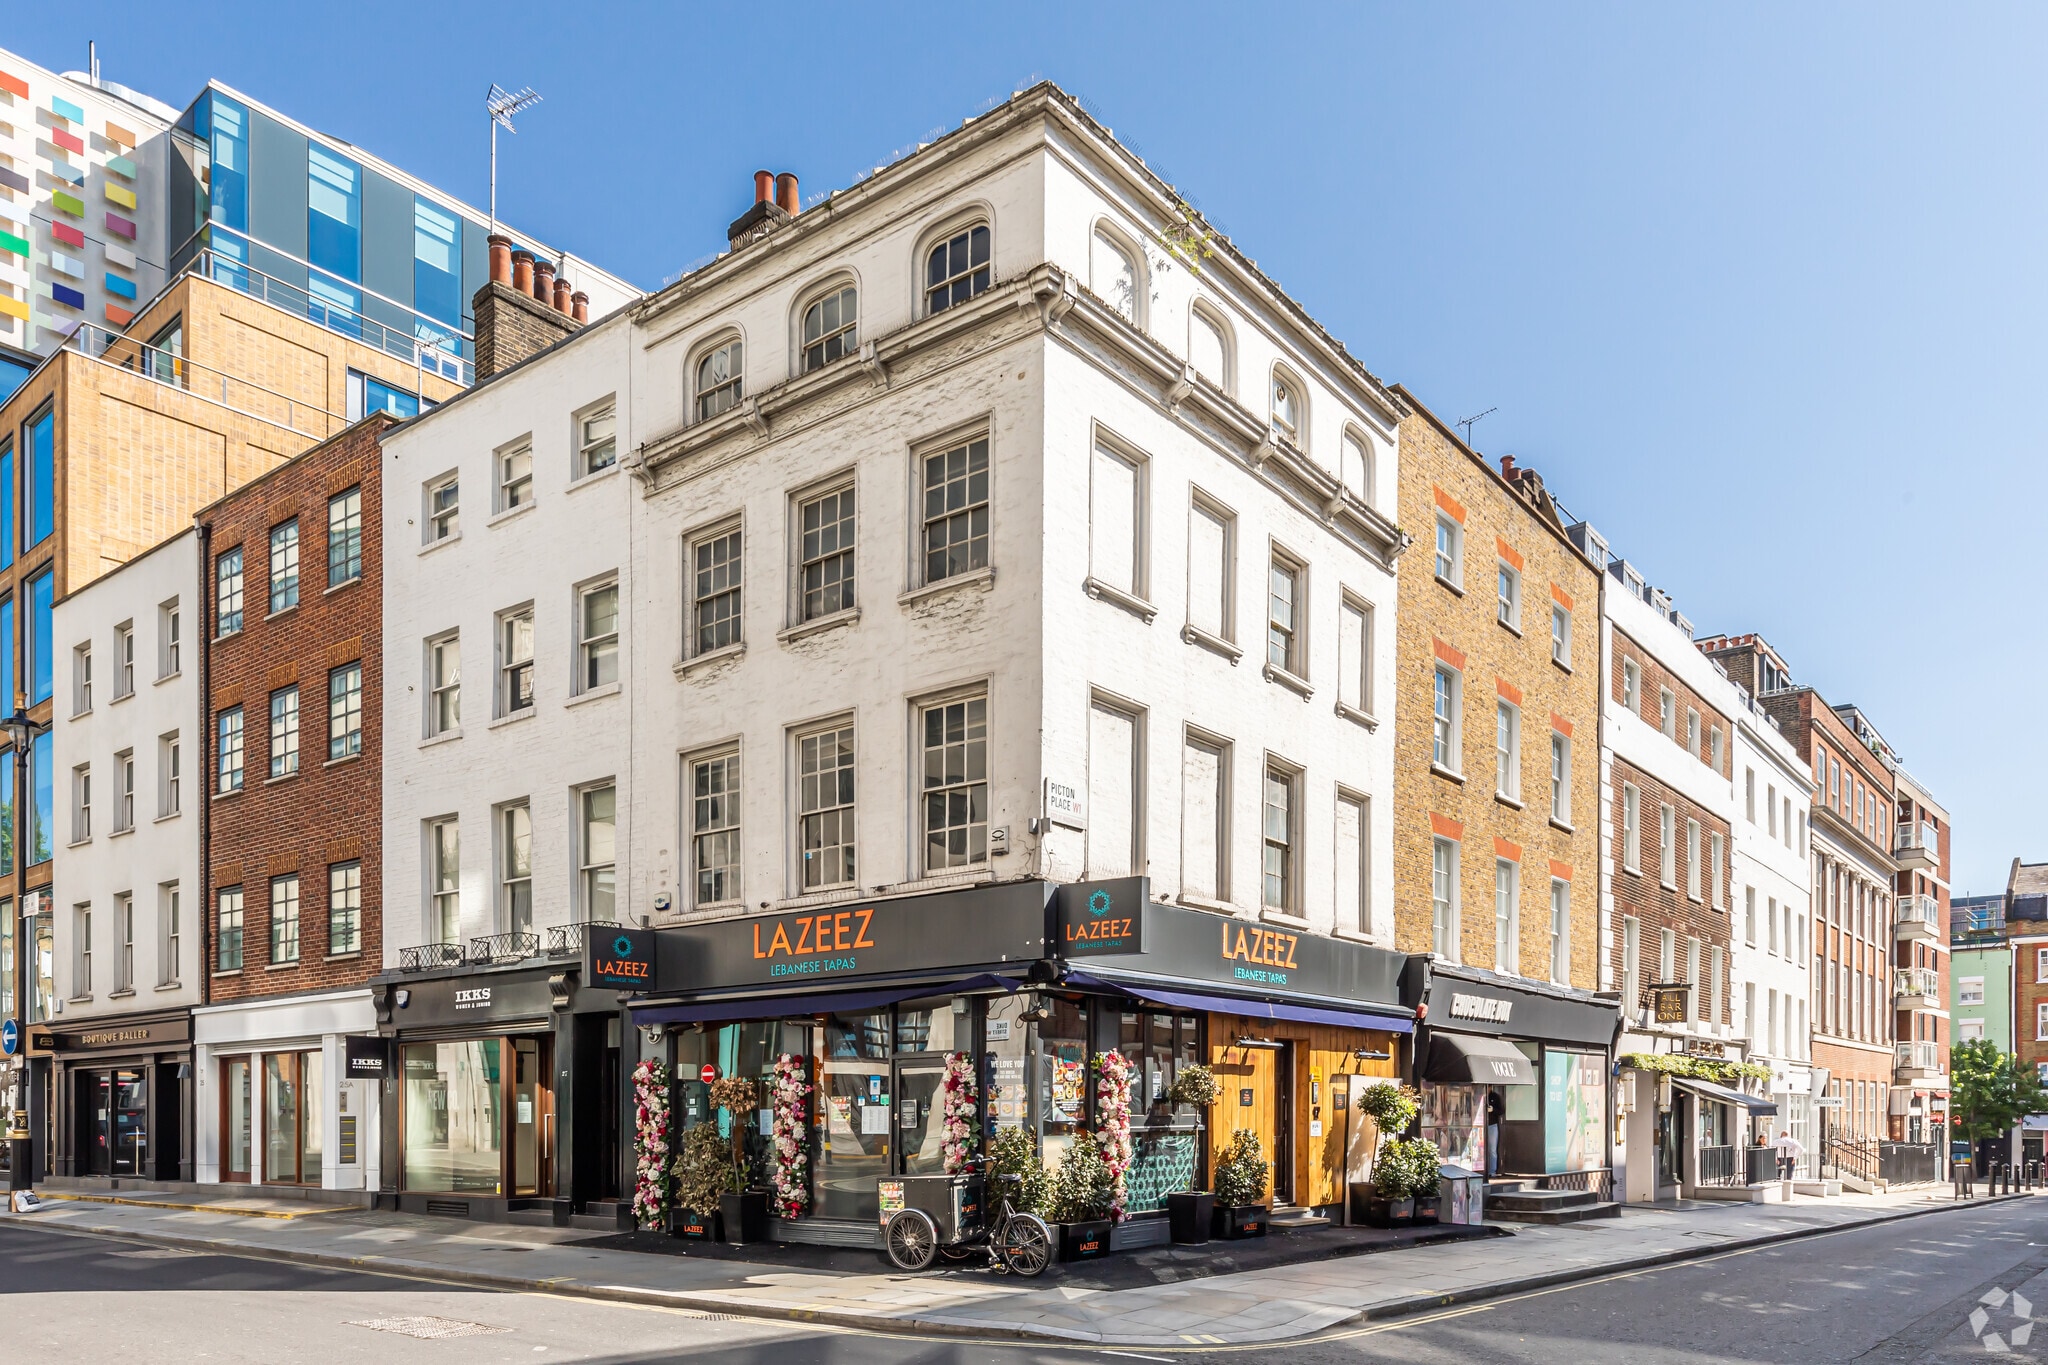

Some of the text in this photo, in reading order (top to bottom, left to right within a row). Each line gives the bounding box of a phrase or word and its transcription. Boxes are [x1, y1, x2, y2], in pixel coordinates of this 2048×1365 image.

[1051, 783, 1075, 799] PICTON
[1051, 796, 1071, 811] PLACE
[754, 909, 875, 959] LAZEEZ
[1066, 918, 1132, 941] LAZEEZ
[1223, 922, 1298, 969] LAZEEZ
[597, 960, 649, 977] LAZEEZ
[770, 957, 856, 976] LEBANESE TAPAS
[1234, 967, 1287, 985] LEBANESE TAPAS
[455, 988, 491, 1002] IKKS
[1661, 993, 1681, 1002] ALL
[1660, 1003, 1682, 1011] BAR
[1657, 1011, 1683, 1020] ONE
[82, 1030, 148, 1044] BOUTIQUE BALLER
[351, 1058, 382, 1066] IKKS
[991, 1060, 1025, 1068] WE LOVE YOU
[1491, 1061, 1517, 1078] VOGUE
[684, 1225, 703, 1234] LAZEEZ
[1080, 1241, 1099, 1251] LAZEEZ
